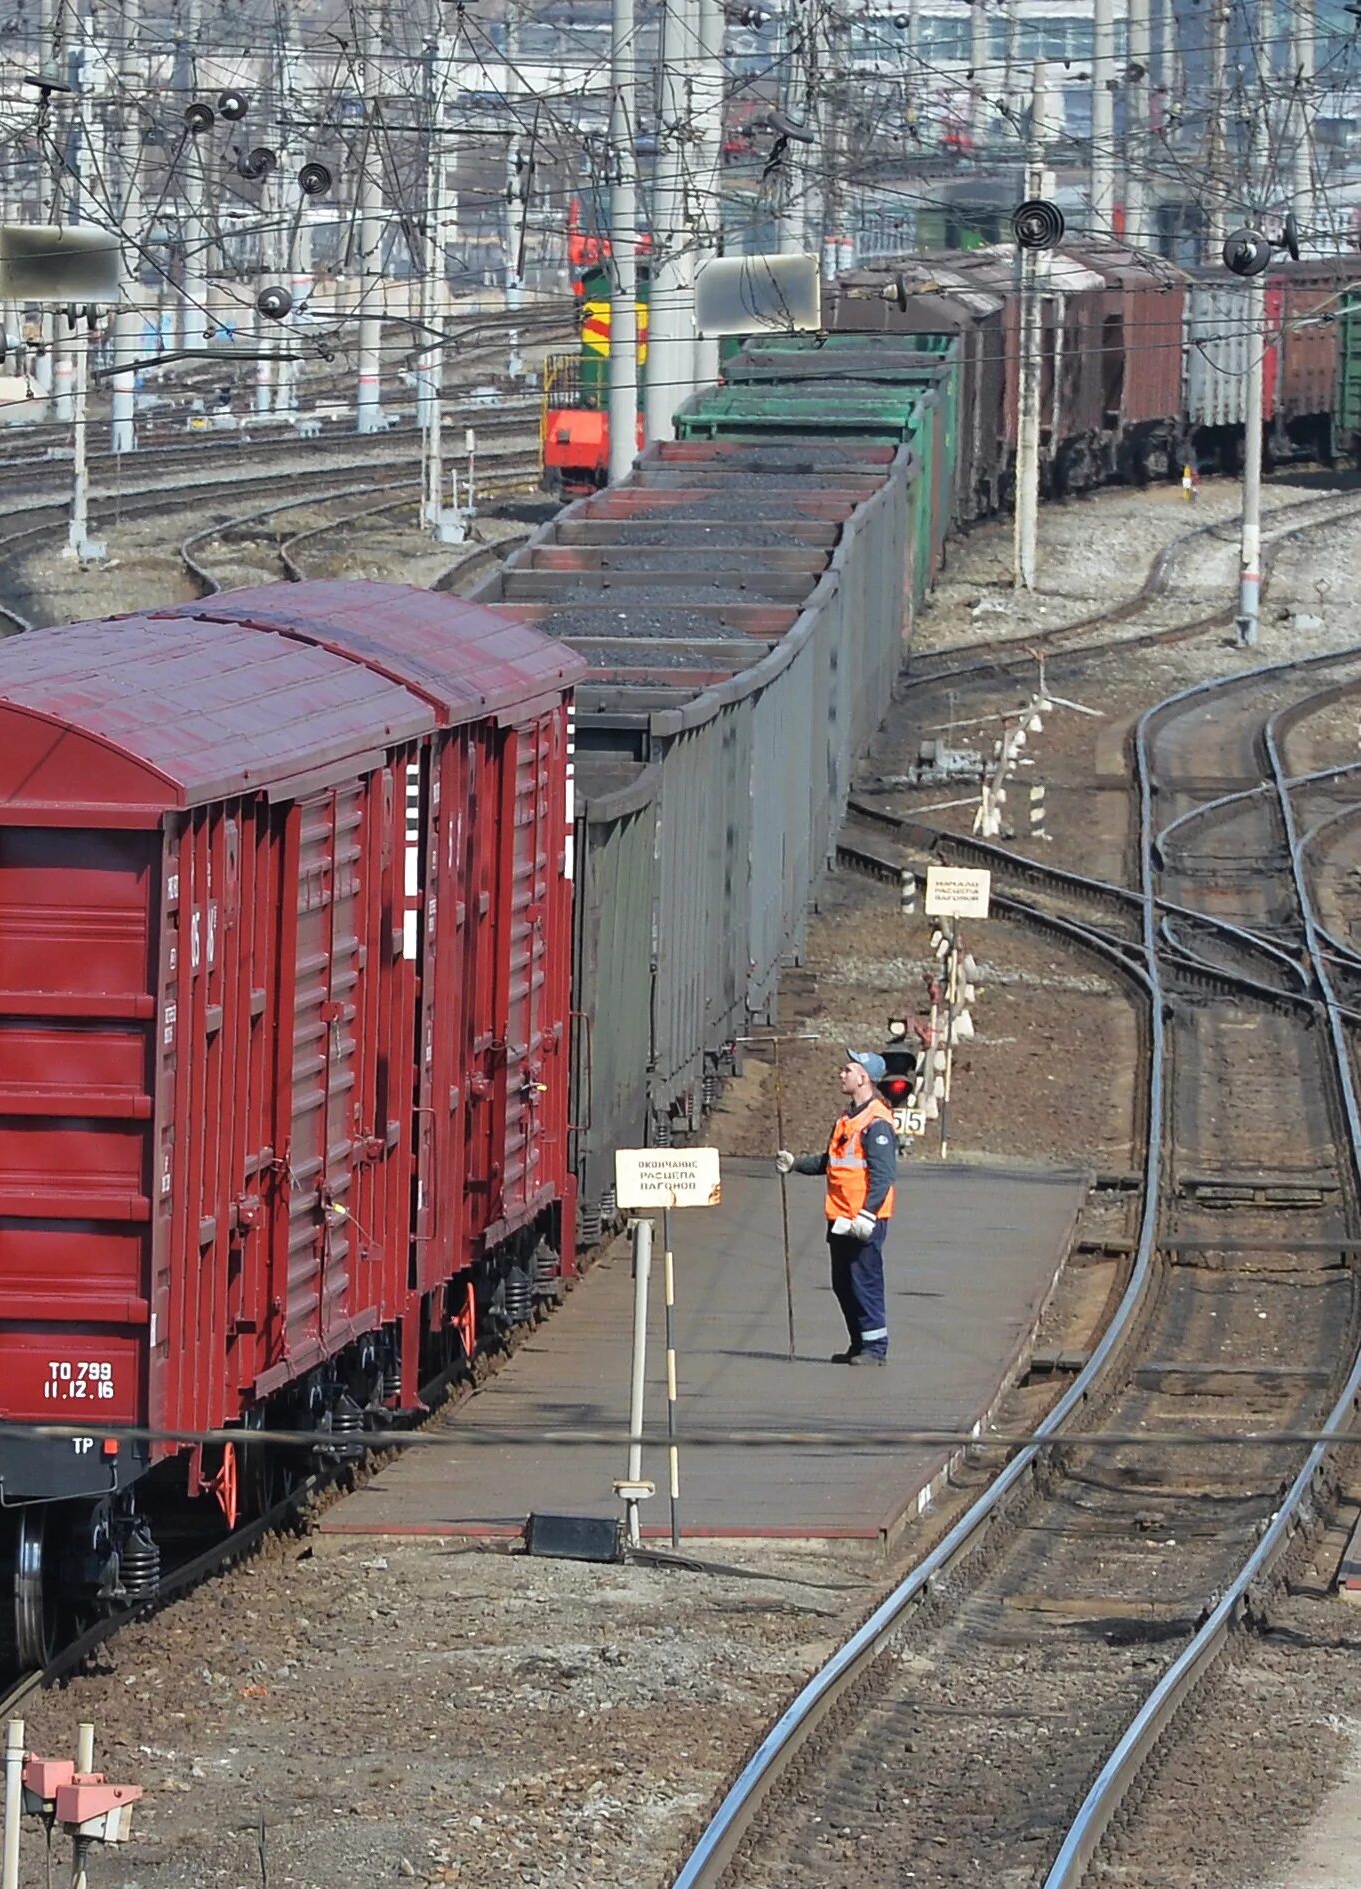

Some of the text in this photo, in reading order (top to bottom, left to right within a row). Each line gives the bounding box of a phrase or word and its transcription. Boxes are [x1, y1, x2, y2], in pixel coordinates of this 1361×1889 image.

[640, 1171, 696, 1180] РАСЦЕПА
[77, 1362, 112, 1380] 799
[44, 1380, 114, 1399] 11.12.16
